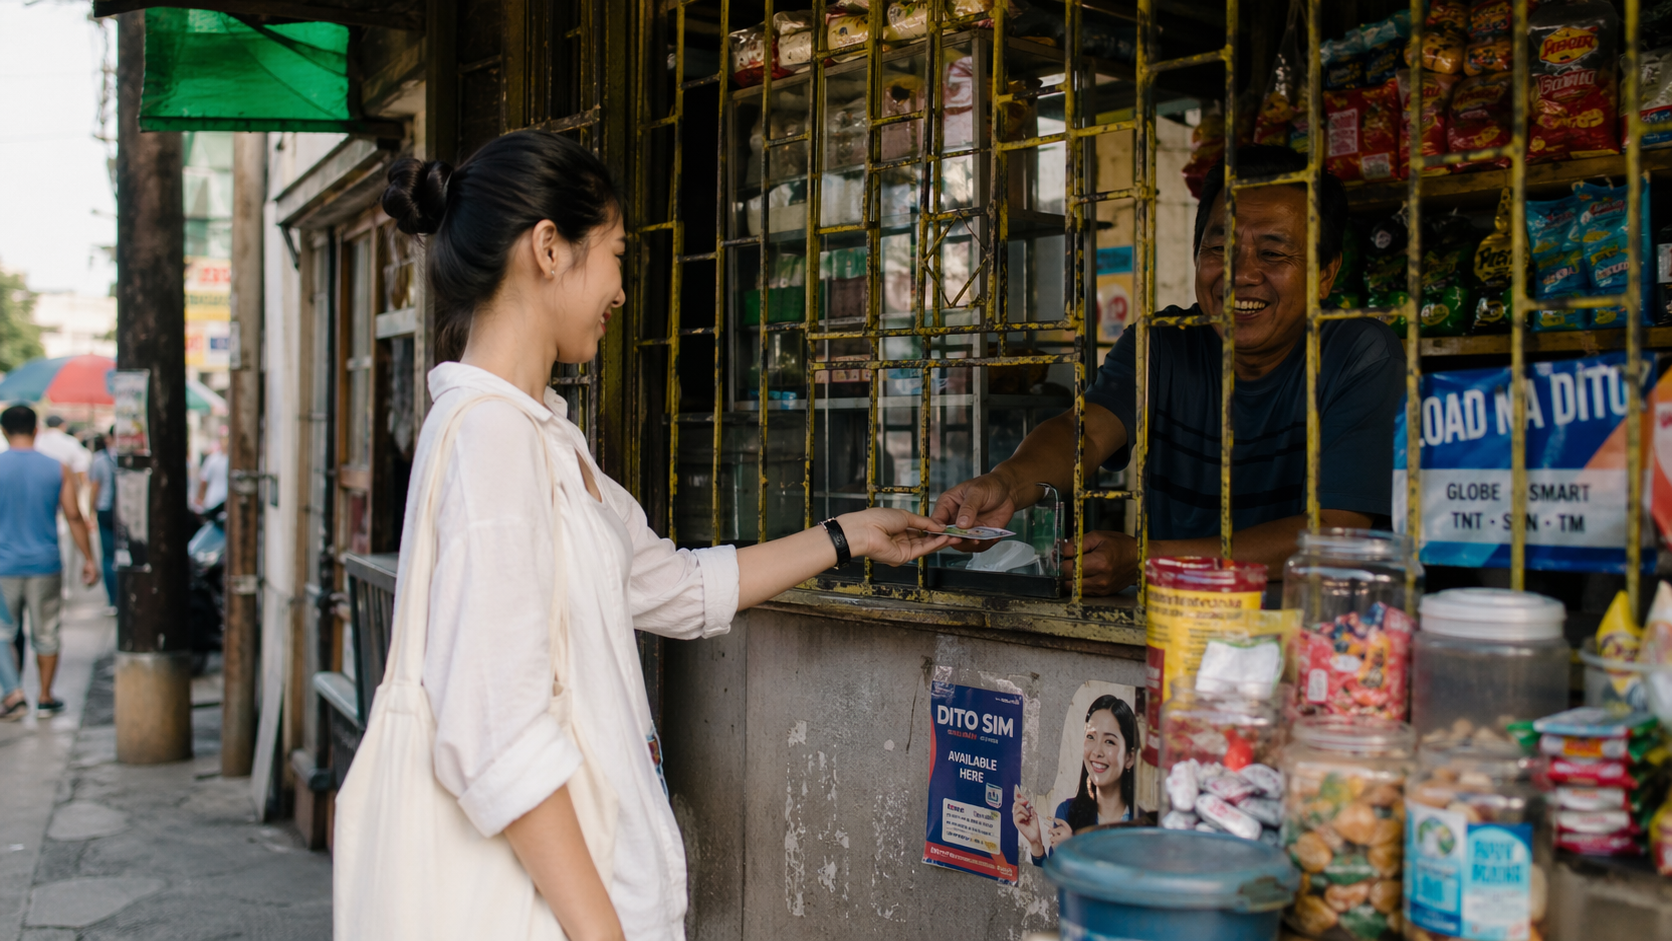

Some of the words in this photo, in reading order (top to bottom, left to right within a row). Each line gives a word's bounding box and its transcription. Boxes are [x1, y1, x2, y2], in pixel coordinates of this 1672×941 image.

[1418, 390, 1487, 446] OAD
[1446, 483, 1501, 501] GLOBE
[1529, 484, 1590, 502] SMART
[1452, 512, 1482, 530] TNT
[1503, 513, 1538, 532] SN
[1558, 514, 1585, 533] TM
[937, 704, 978, 731] DITO
[982, 713, 1014, 738] SIM
[948, 750, 997, 771] AVAILABLE
[959, 767, 984, 783] HERE
